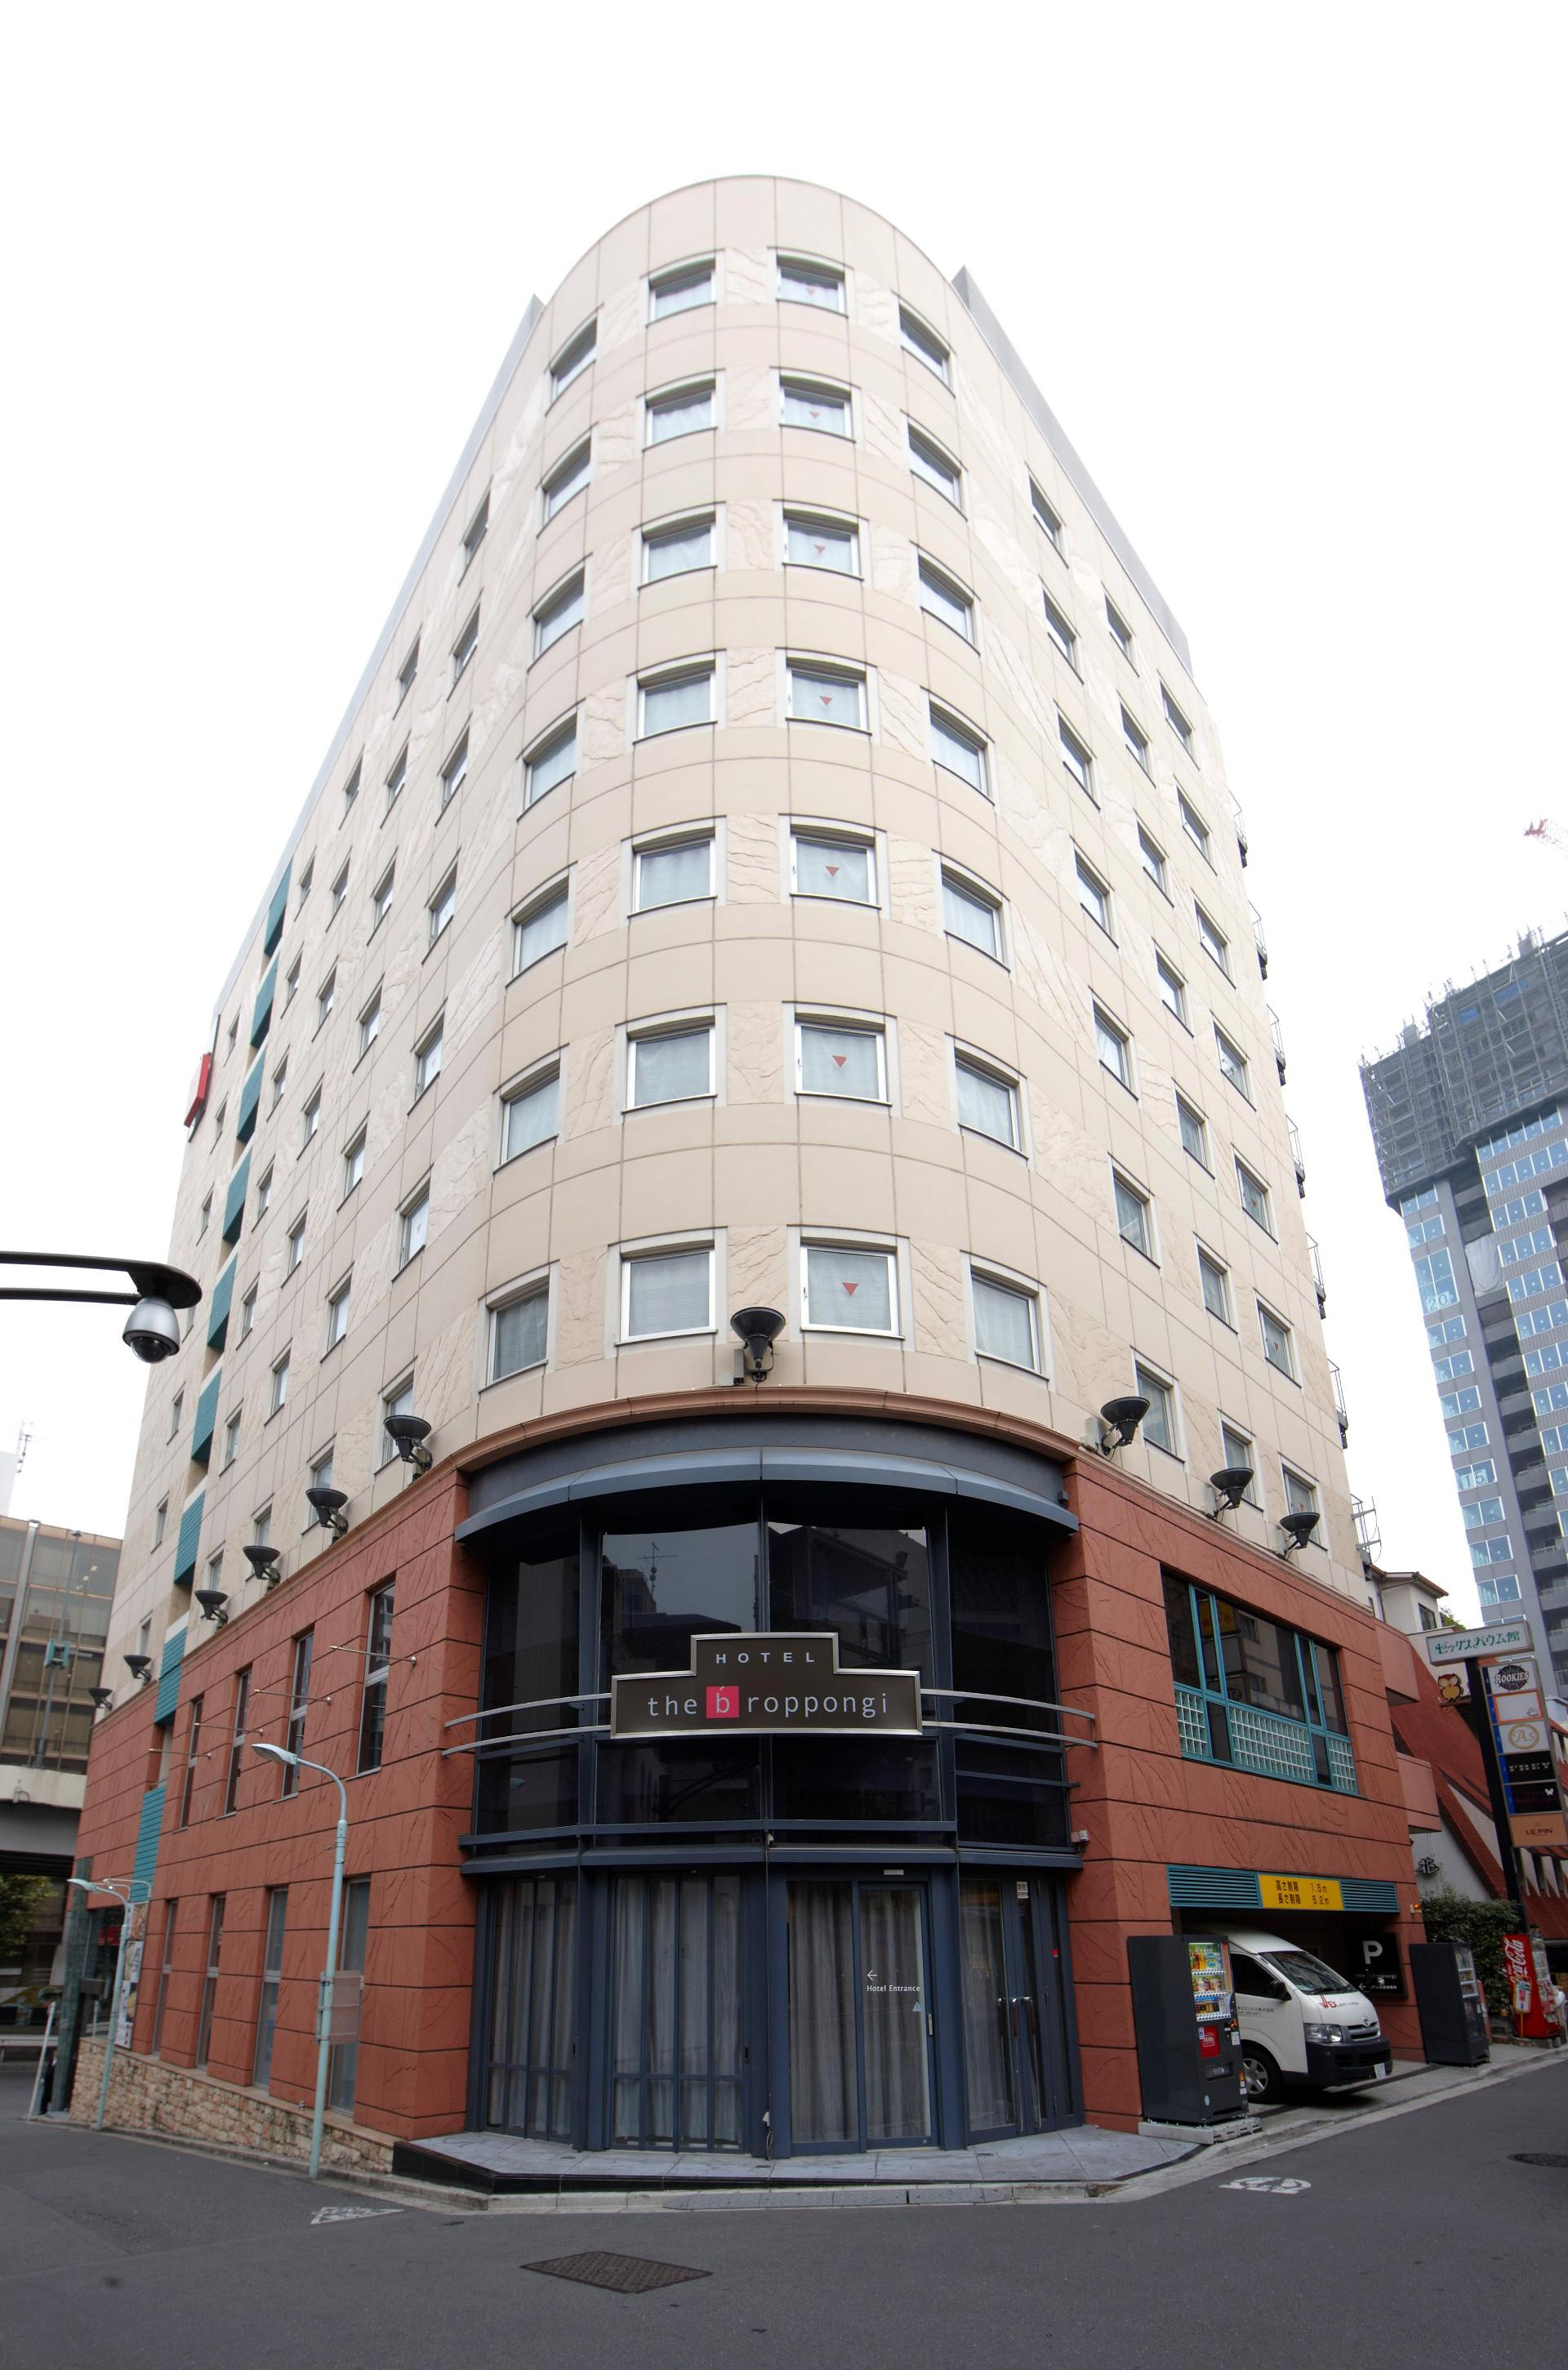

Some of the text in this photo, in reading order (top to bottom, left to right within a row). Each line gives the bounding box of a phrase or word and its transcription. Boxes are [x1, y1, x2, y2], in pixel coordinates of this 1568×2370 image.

[715, 1652, 815, 1664] HOTEL
[1495, 1672, 1529, 1684] ROOKIES
[648, 1695, 697, 1716] the
[748, 1692, 888, 1718] roppongi
[1362, 1940, 1383, 1964] P
